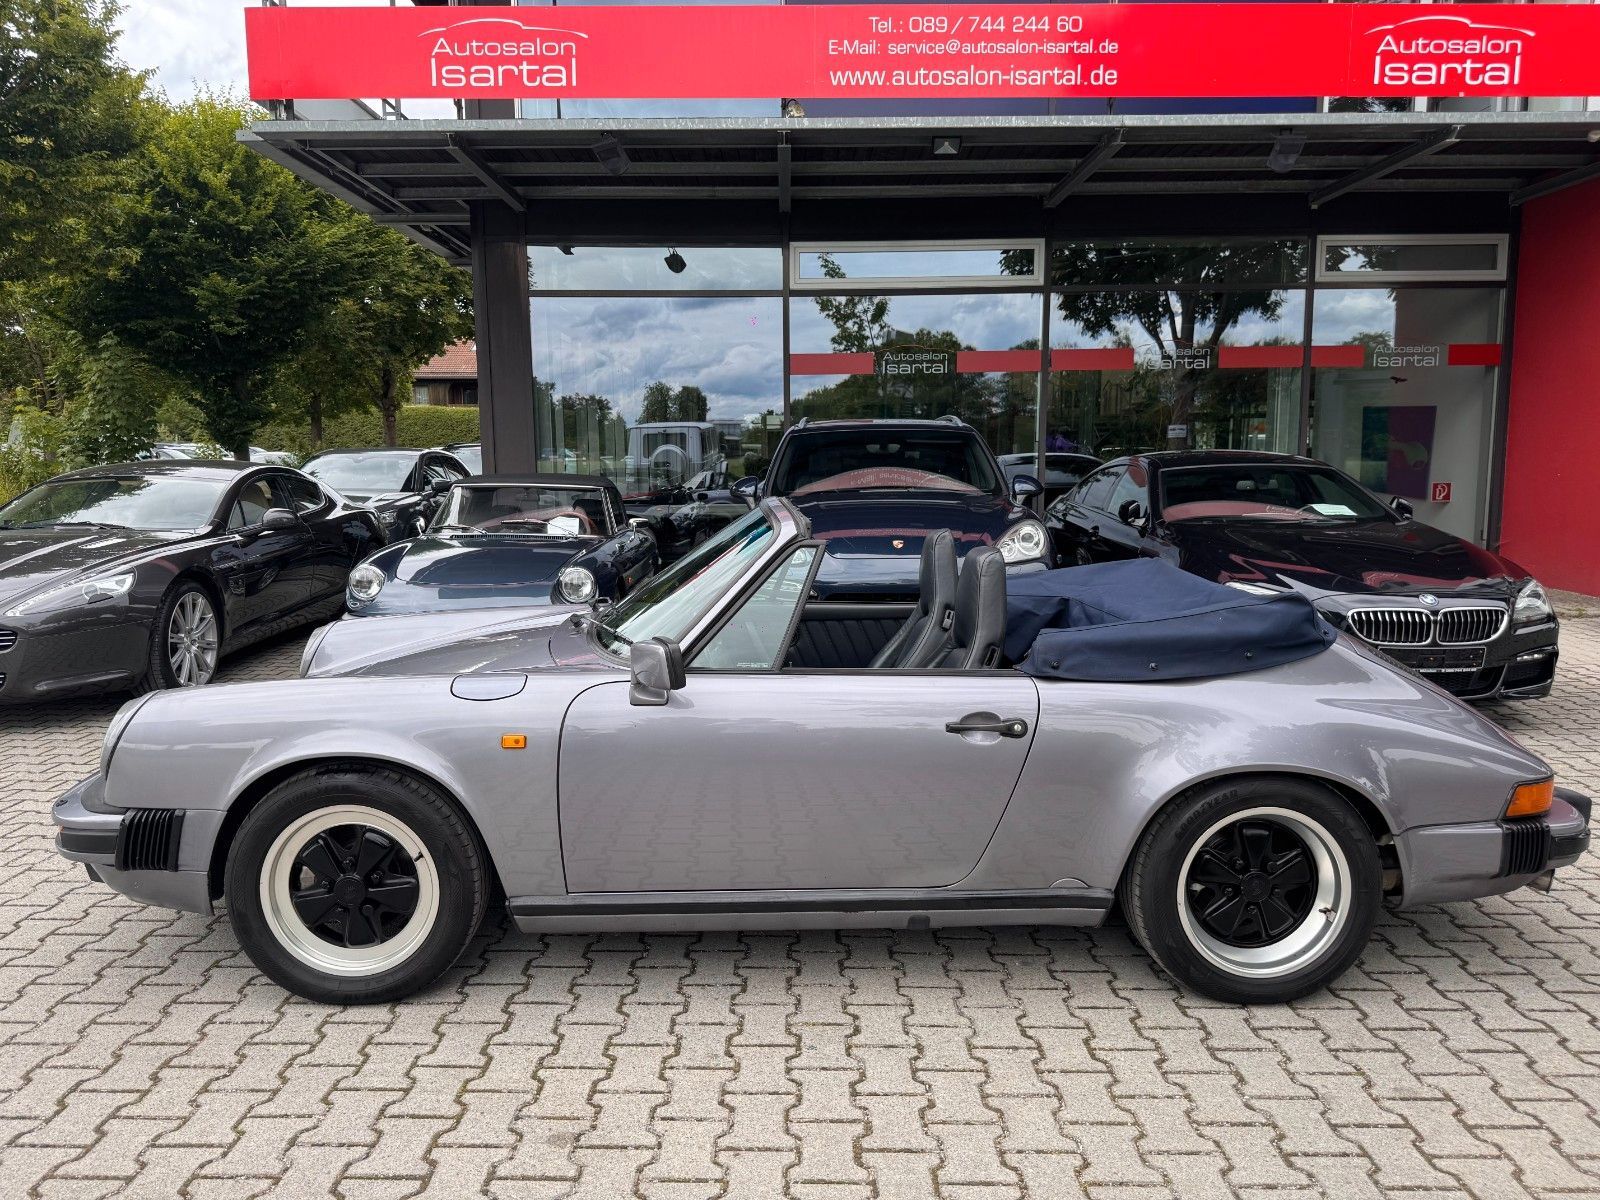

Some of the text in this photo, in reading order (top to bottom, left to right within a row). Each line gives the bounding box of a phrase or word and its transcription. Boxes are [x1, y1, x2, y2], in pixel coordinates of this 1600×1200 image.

[868, 16, 903, 33] Tel.:
[968, 16, 1006, 33] 744
[1012, 15, 1051, 33] 244
[1056, 15, 1083, 33] 60
[431, 37, 576, 57] Autosalon
[828, 38, 1119, 55] E-Mail: service@autosalon-isartal.de
[1375, 34, 1522, 55] Autosalon
[430, 57, 577, 87] Isartal
[829, 64, 1118, 86] www.autosalon-isartal.de
[1373, 54, 1521, 85] Isartal
[882, 351, 948, 361] Autosalon
[1374, 344, 1440, 354] Autosalon
[882, 360, 948, 375] Isartal
[1373, 352, 1440, 367] Isartal
